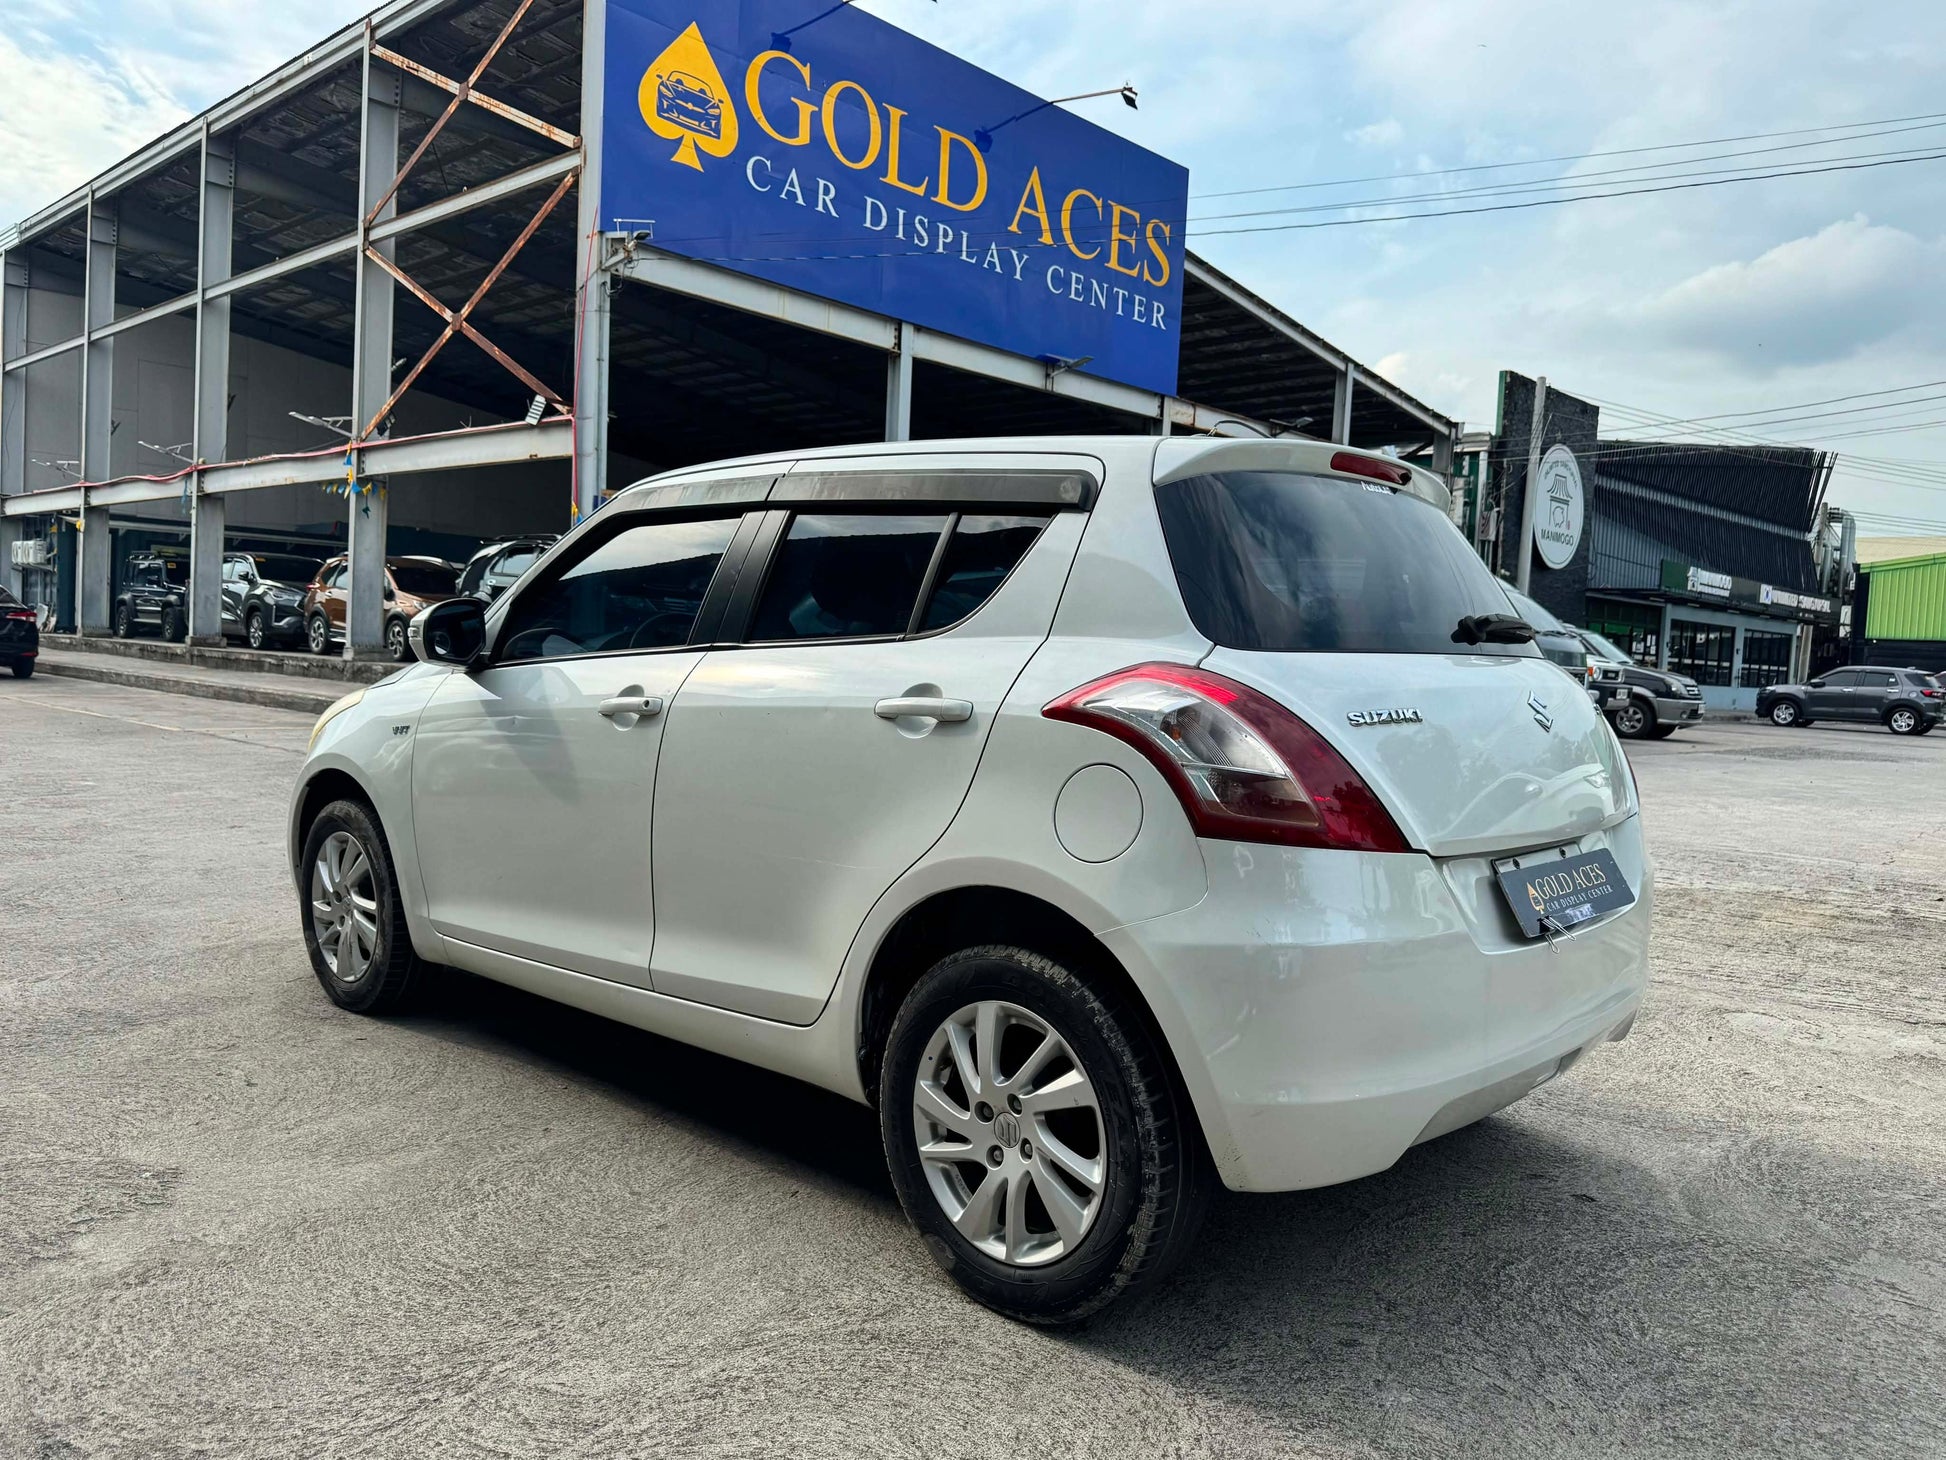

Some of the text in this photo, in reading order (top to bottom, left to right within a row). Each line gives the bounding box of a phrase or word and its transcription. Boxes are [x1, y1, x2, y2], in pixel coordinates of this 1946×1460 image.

[745, 49, 1172, 288] GOLD ACES
[745, 155, 1167, 331] CAR DISPLAY CENTER
[1541, 528, 1574, 546] MANIMOGO
[1347, 708, 1424, 727] SUZUKI
[1535, 863, 1606, 900] GOLD ACES
[1546, 901, 1560, 912] CAR
[1560, 892, 1588, 908] DISPLAY
[1588, 884, 1613, 899] CENTER
